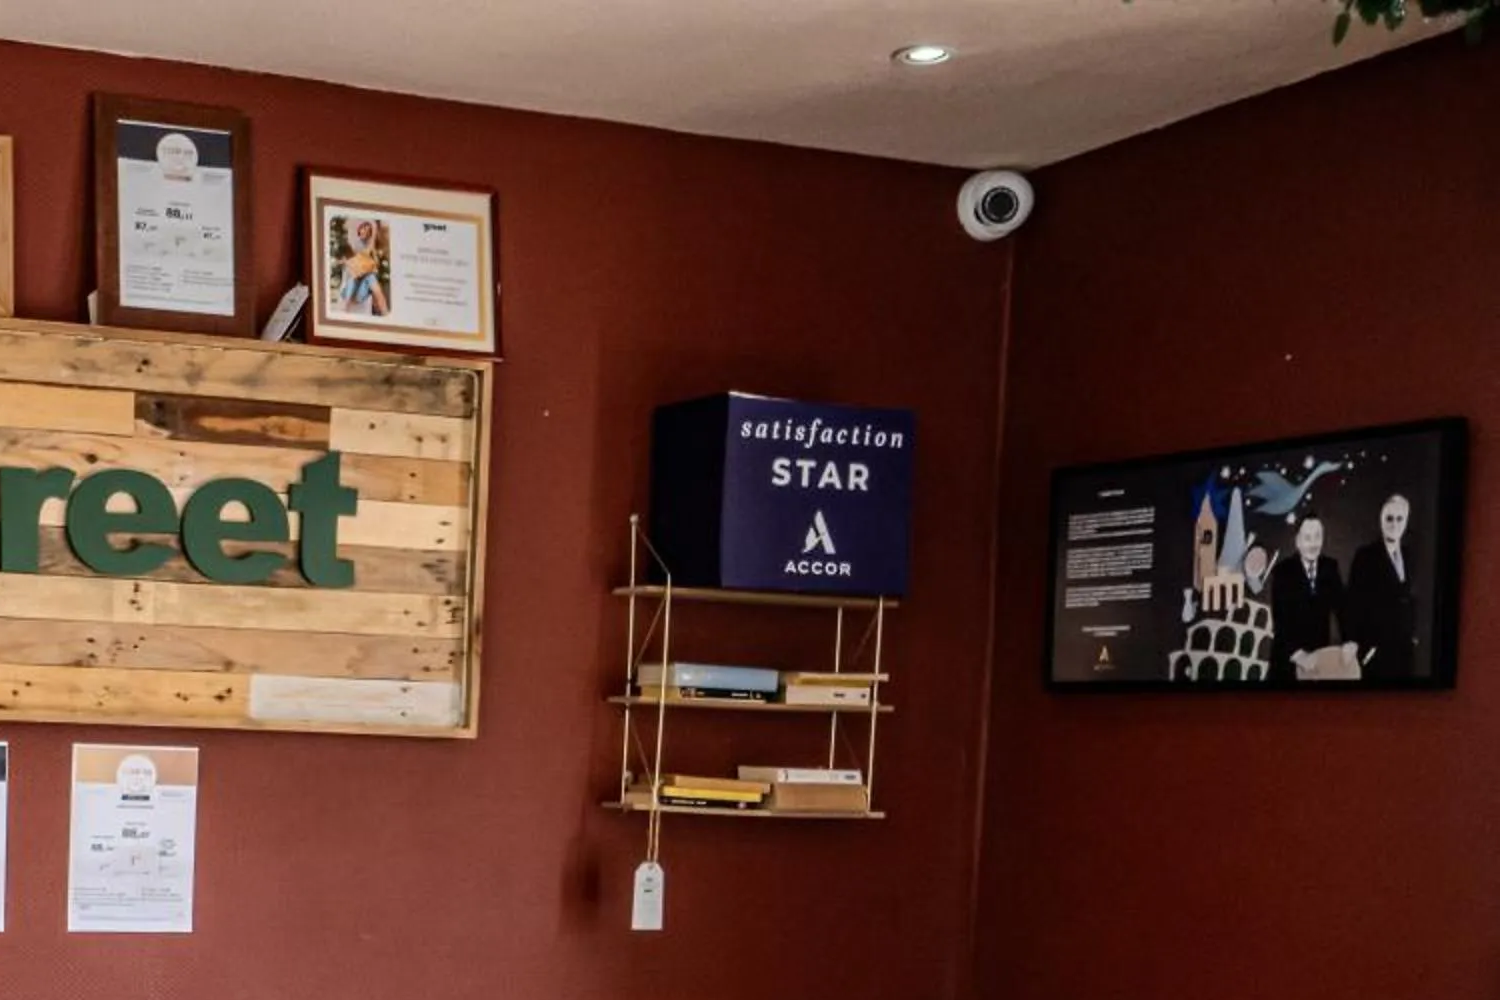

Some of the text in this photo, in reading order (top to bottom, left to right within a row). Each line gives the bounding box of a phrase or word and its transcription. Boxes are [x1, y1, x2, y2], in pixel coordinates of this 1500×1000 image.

[740, 418, 904, 449] satisfaction
[771, 457, 870, 491] STAR
[784, 560, 852, 576] ACCOR
